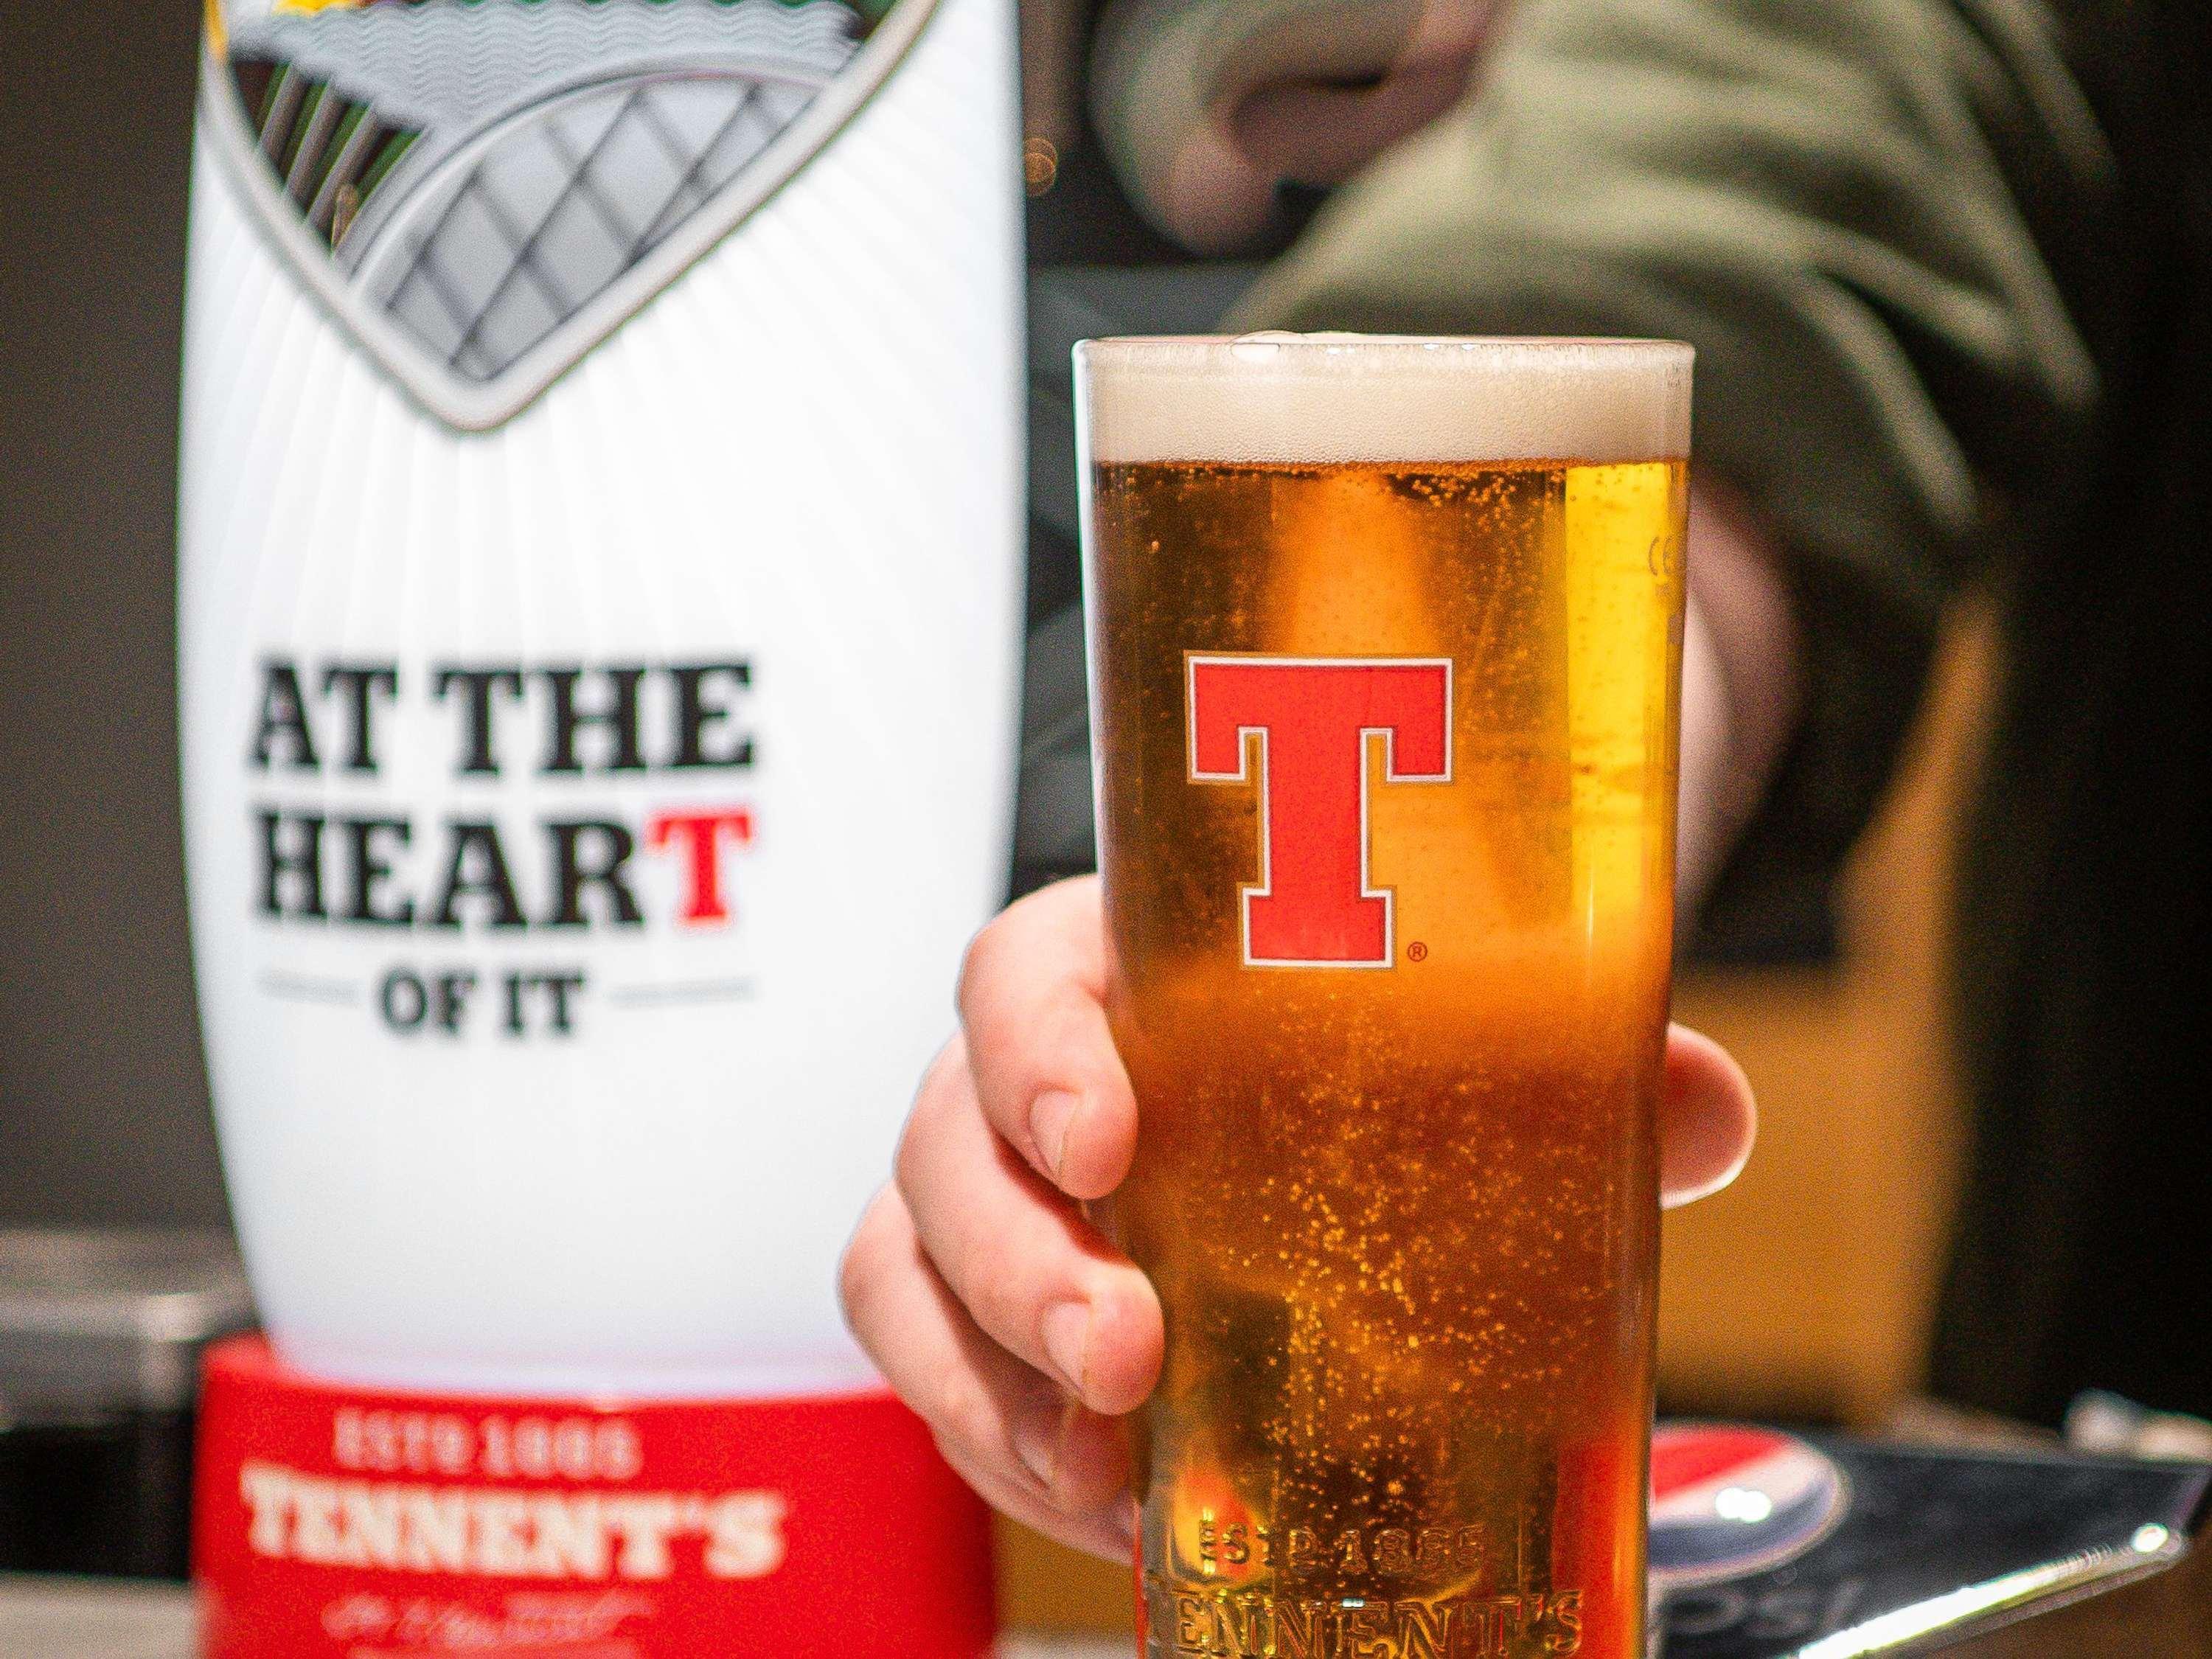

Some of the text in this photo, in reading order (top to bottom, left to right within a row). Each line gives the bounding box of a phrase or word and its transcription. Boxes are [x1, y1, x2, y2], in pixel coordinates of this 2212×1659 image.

[251, 658, 755, 779] AT THE
[254, 808, 753, 932] HEART
[1188, 655, 1453, 969] T
[378, 968, 585, 1036] OF IT
[239, 1460, 786, 1578] TENNENT'S
[1175, 1587, 1584, 1658] ENNENT'S
